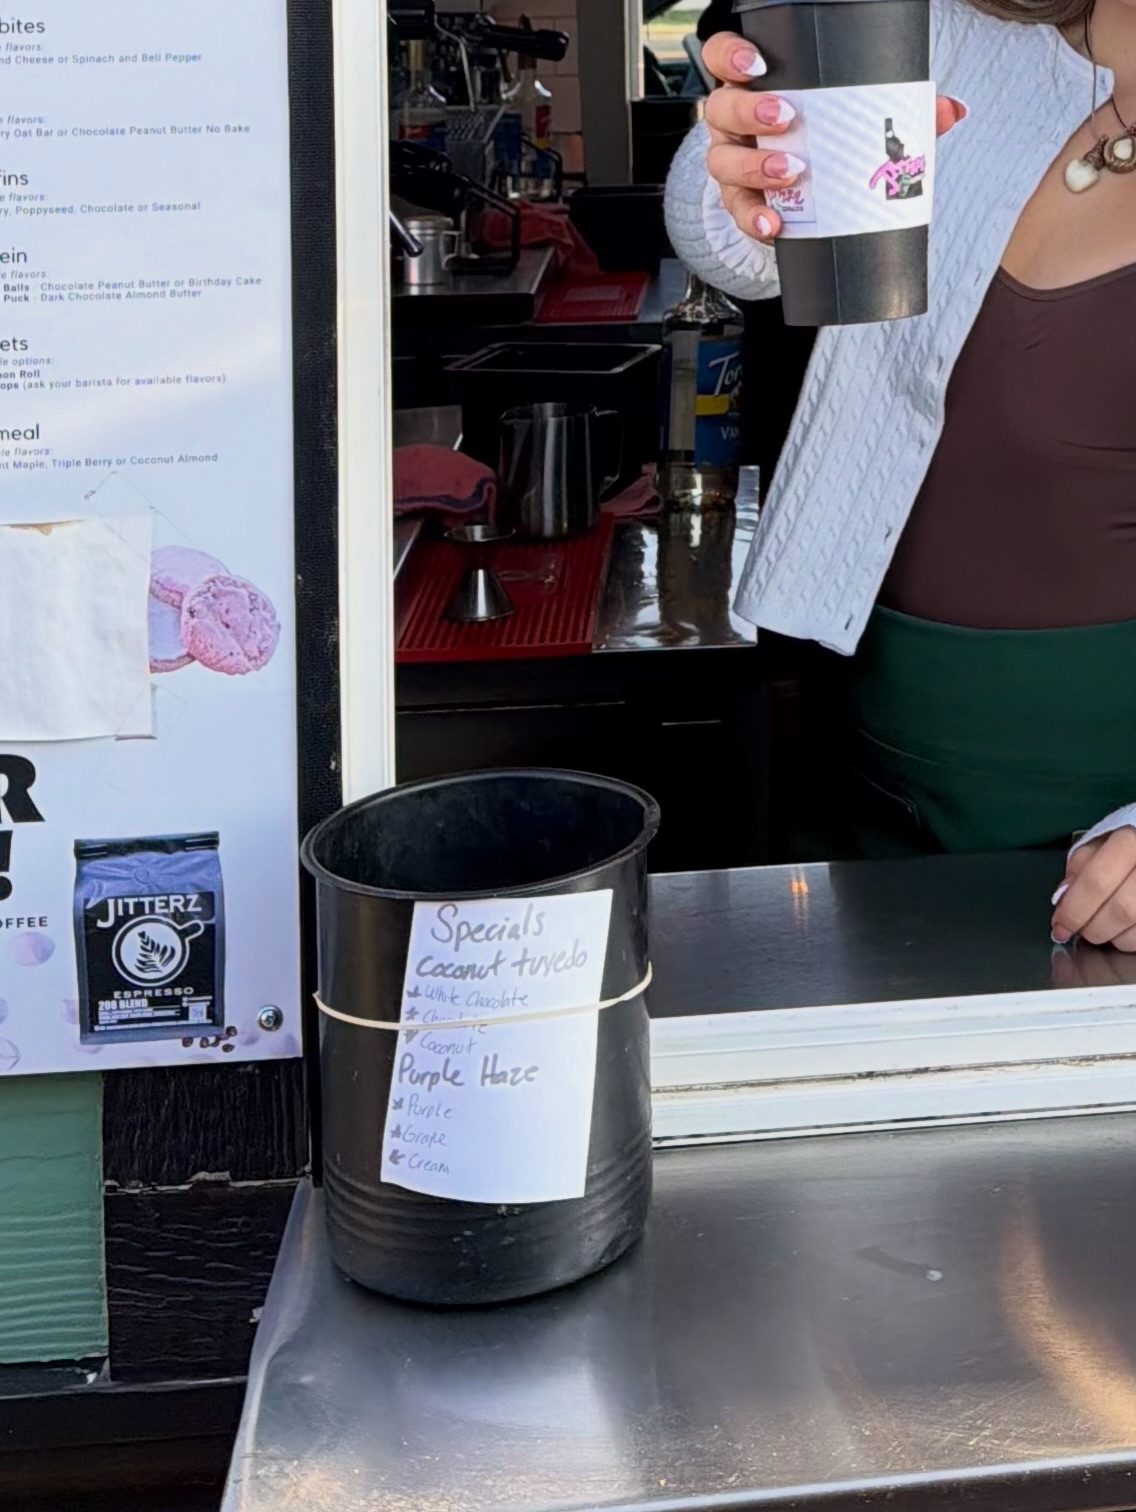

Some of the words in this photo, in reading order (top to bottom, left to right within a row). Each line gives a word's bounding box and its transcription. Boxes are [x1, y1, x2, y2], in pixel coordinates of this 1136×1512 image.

[15, 205, 77, 216] Poppyseed,
[80, 204, 134, 214] Chocolate
[138, 204, 148, 212] or
[152, 201, 201, 212] Seasonal
[41, 281, 94, 292] Chocolate
[98, 280, 135, 290] Peanut
[139, 279, 171, 288] Butter
[174, 278, 185, 287] or
[189, 277, 232, 288] Birthday
[236, 276, 262, 285] Cake
[52, 458, 81, 469] Triple
[85, 457, 112, 468] Berry
[116, 456, 126, 465] or
[130, 454, 174, 465] Coconut
[177, 453, 218, 463] Almond
[96, 893, 203, 928] JITTERZ
[430, 902, 546, 952] Specials
[510, 939, 588, 977] tuxedo
[113, 987, 194, 999] ESPRESSO
[119, 998, 148, 1008] BLEND
[465, 987, 528, 1010] Chocolate
[419, 1032, 478, 1054] Coconut
[398, 1052, 465, 1092] Purple
[480, 1053, 539, 1087] Haze
[407, 1093, 453, 1119] Purple
[402, 1124, 447, 1146] Grape
[407, 1153, 450, 1174] Cream
